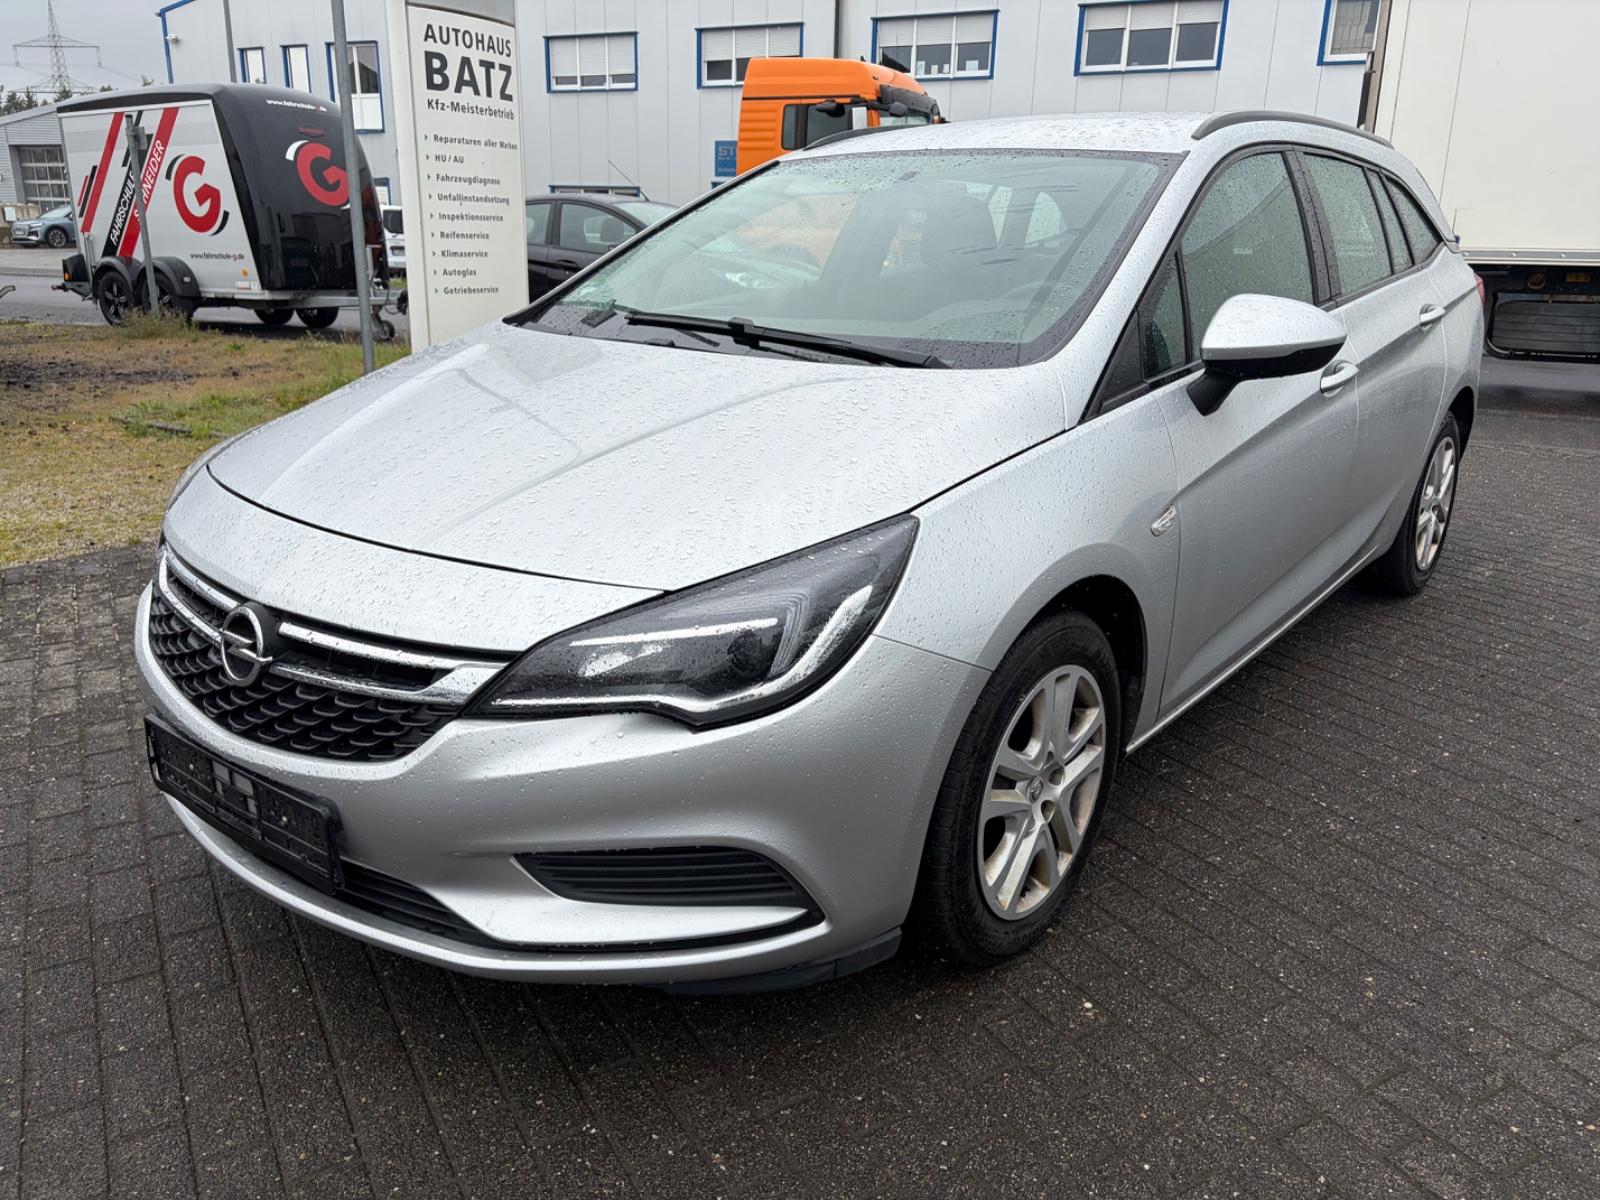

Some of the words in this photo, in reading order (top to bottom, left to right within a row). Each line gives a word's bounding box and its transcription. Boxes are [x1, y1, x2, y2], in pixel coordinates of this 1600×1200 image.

[424, 23, 512, 58] AUTOHAUS
[424, 50, 513, 102] BATZ
[427, 98, 514, 120] Kfz-Meisterbetrieb
[433, 134, 482, 146] Reparaturen
[484, 138, 498, 148] aller
[499, 140, 518, 150] Marken
[435, 154, 447, 163] HU
[453, 155, 465, 164] AU
[133, 139, 165, 222] SHNEIDER
[296, 142, 350, 206] G
[436, 173, 501, 186] Fahrzeugdiagnose
[173, 155, 221, 233] G
[437, 193, 510, 206] Unfallinstandsetzung
[439, 212, 504, 222] Inspektionsservice
[440, 230, 490, 240] Reifenservice
[441, 249, 488, 258] Klimaservice
[442, 268, 477, 278] Autoglas
[443, 285, 499, 295] Getriebeservice
